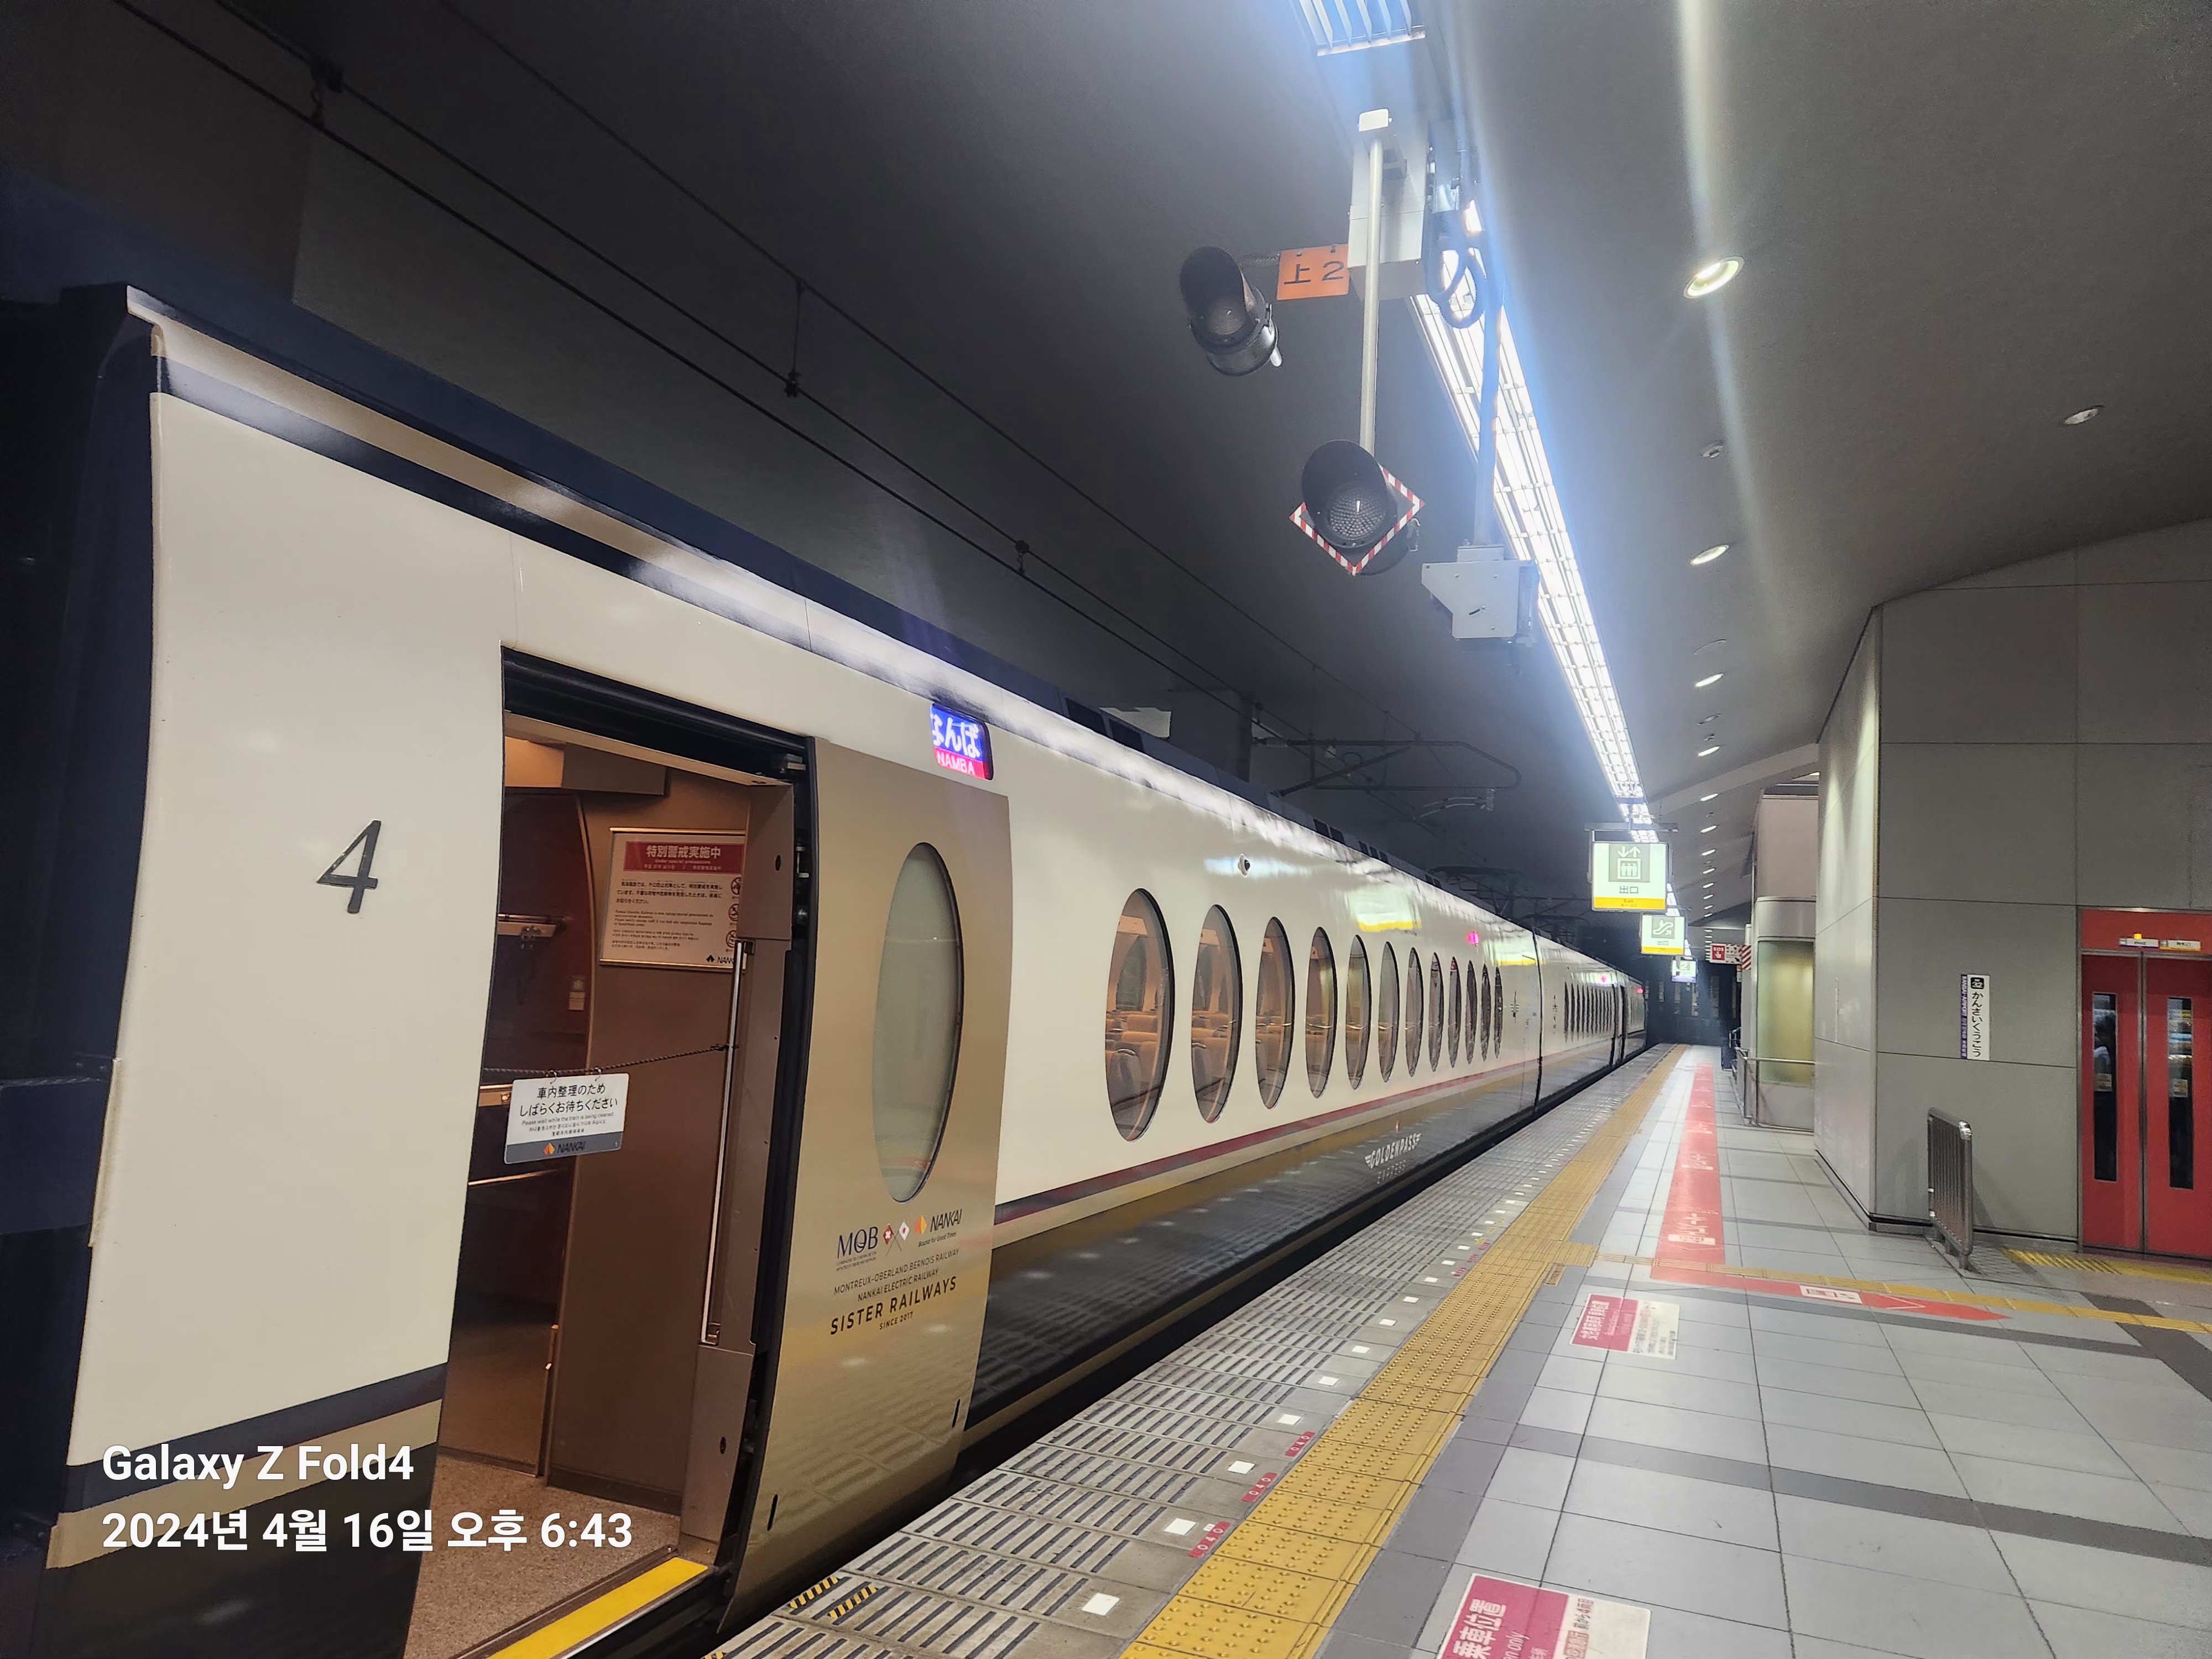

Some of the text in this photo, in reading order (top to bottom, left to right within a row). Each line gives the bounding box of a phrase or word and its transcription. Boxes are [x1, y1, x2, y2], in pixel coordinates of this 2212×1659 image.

[936, 751, 975, 776] NAMBA
[646, 845, 721, 859] 特別警戒実施中
[317, 820, 382, 914] 4
[1619, 885, 1639, 894] 出口
[1971, 992, 1984, 1057] かんさいくうこう
[537, 1083, 606, 1099] 車内整理のため
[519, 1098, 618, 1117] しばらくお待ちください
[556, 1141, 586, 1154] NANKAI
[930, 1208, 962, 1233] NANKAI
[837, 1226, 878, 1259] MOB
[834, 1264, 909, 1295] MONTREUX-OBERLAND
[909, 1255, 935, 1270] BERNOIS
[936, 1249, 960, 1261] RAILWAY
[858, 1267, 939, 1302] NANKAI ELECTRIC RAILWAY
[830, 1276, 957, 1335] SISTER RAILWAYS
[879, 1311, 914, 1330] SINCE 2017
[1452, 1598, 1507, 1659] 乗車位置
[1505, 1631, 1530, 1651] only
